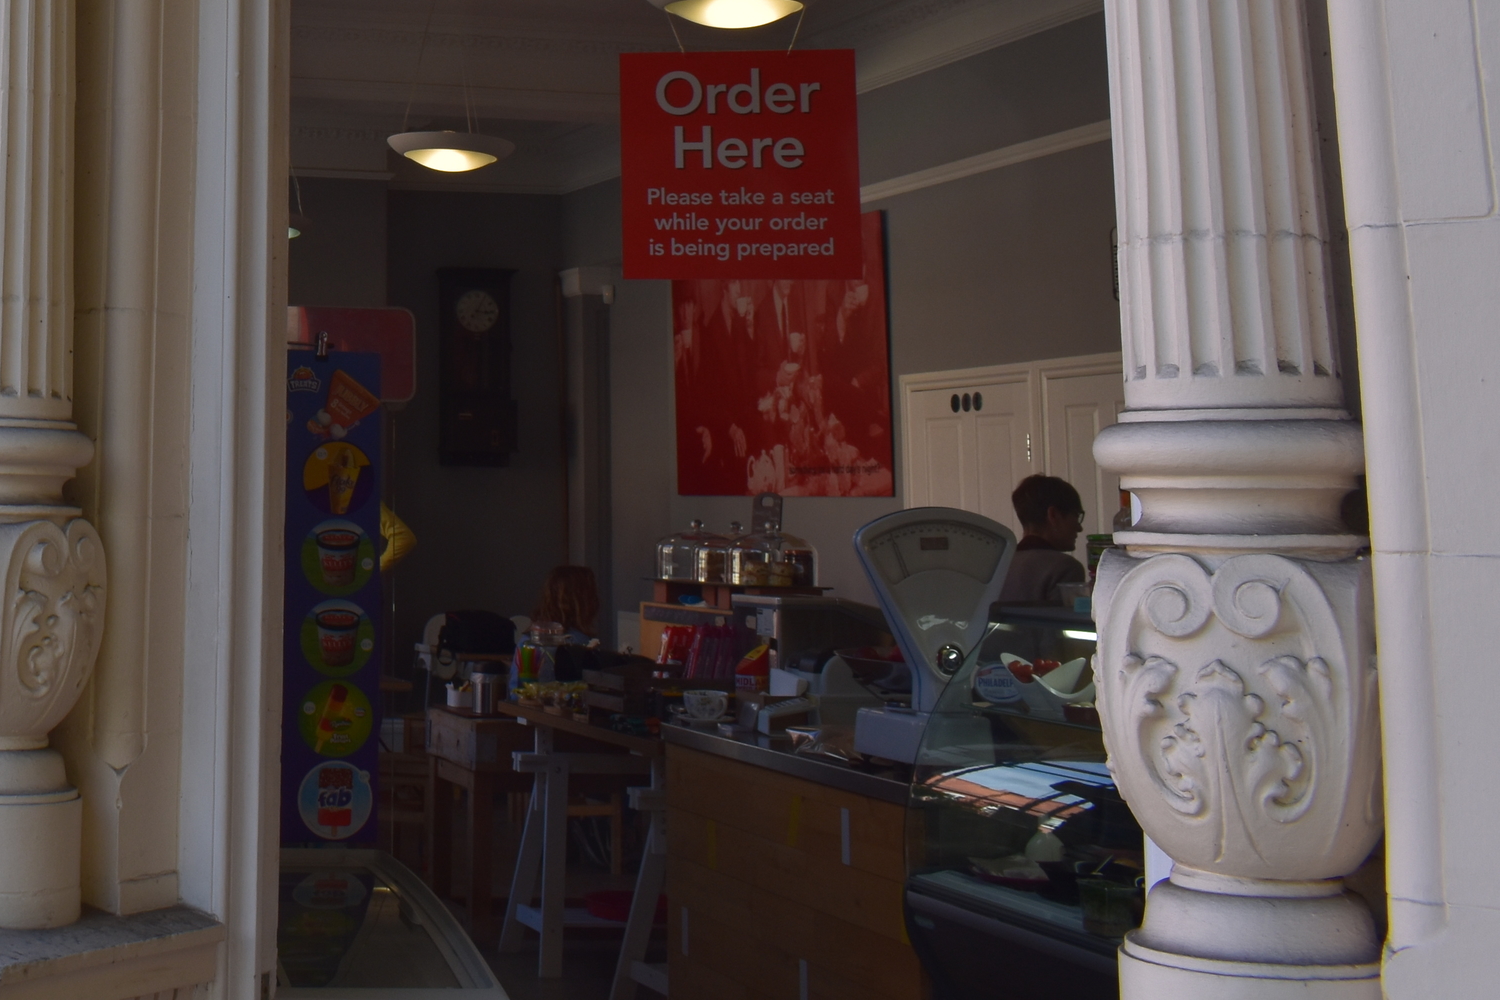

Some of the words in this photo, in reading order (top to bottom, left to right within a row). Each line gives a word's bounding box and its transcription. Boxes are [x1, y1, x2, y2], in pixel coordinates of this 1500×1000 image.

[655, 67, 821, 115] Order
[674, 125, 805, 169] Here
[647, 187, 713, 205] Please
[719, 187, 765, 205] take
[772, 191, 783, 205] a
[790, 188, 835, 205] seat
[654, 212, 709, 230] while
[715, 216, 763, 235] your
[769, 212, 828, 230] order
[649, 238, 665, 256] is
[671, 237, 730, 261] being
[737, 237, 835, 261] prepared
[318, 786, 352, 807] fab
